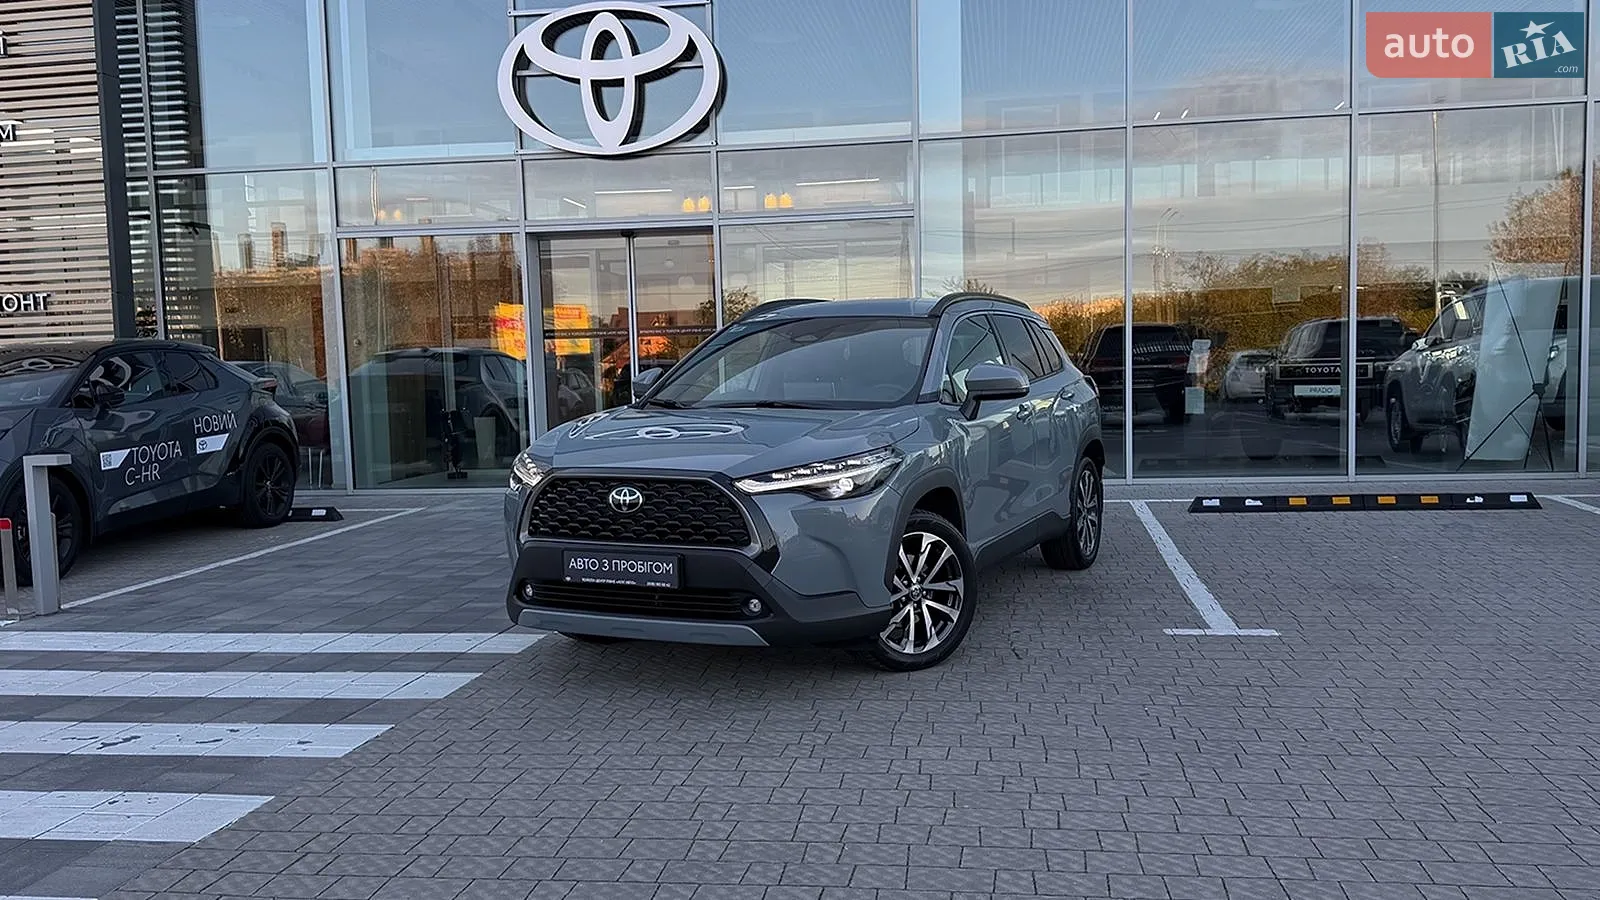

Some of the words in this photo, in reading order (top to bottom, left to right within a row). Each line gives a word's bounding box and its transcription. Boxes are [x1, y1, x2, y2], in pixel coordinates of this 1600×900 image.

[1305, 366, 1342, 374] TOYOTA
[193, 410, 238, 434] НОВИЙ
[131, 440, 182, 465] TOYOTA
[125, 462, 161, 486] C-HR
[568, 558, 599, 571] АВТО
[612, 560, 673, 575] ПРОБІГОМ
